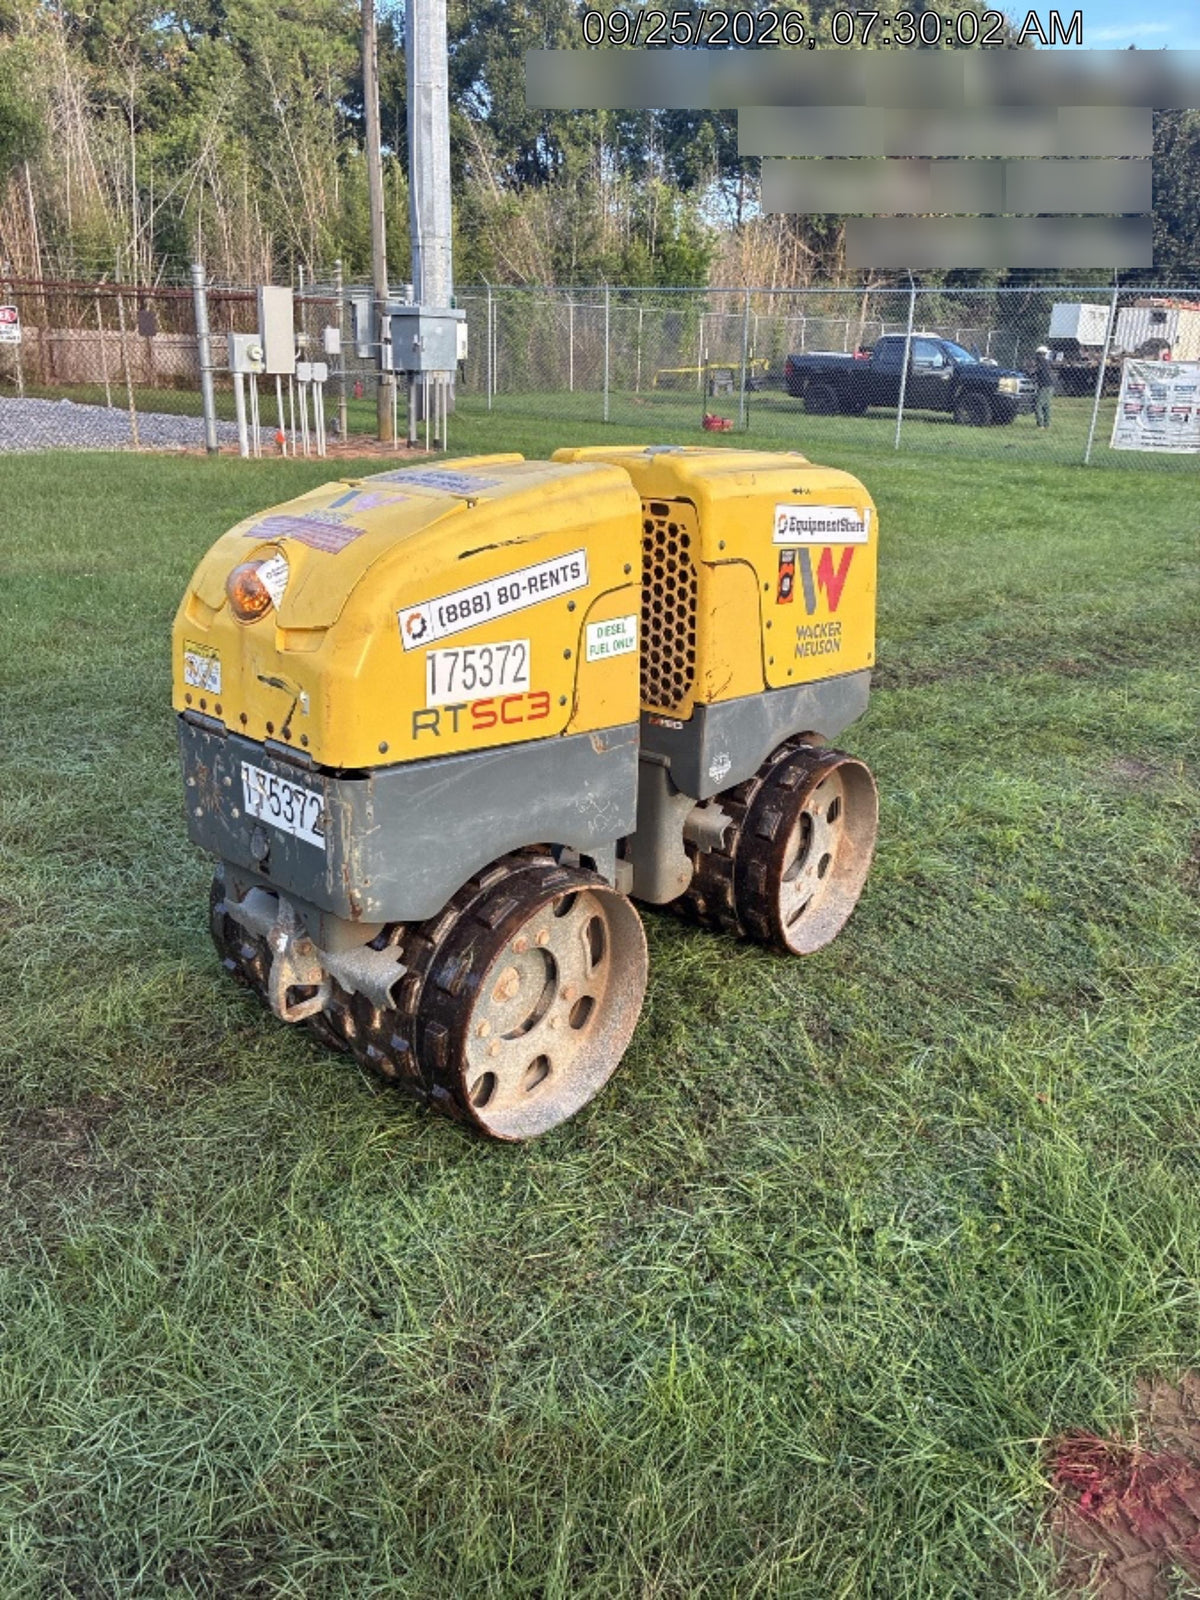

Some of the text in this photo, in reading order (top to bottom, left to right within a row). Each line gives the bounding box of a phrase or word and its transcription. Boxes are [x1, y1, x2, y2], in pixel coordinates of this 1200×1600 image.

[438, 561, 581, 628] (888) 80-RENTS
[596, 622, 626, 639] DIESEL
[796, 621, 842, 641] WACKER
[590, 636, 635, 657] FUEL ONLY
[794, 638, 841, 660] NEUSON
[427, 643, 527, 696] 175372
